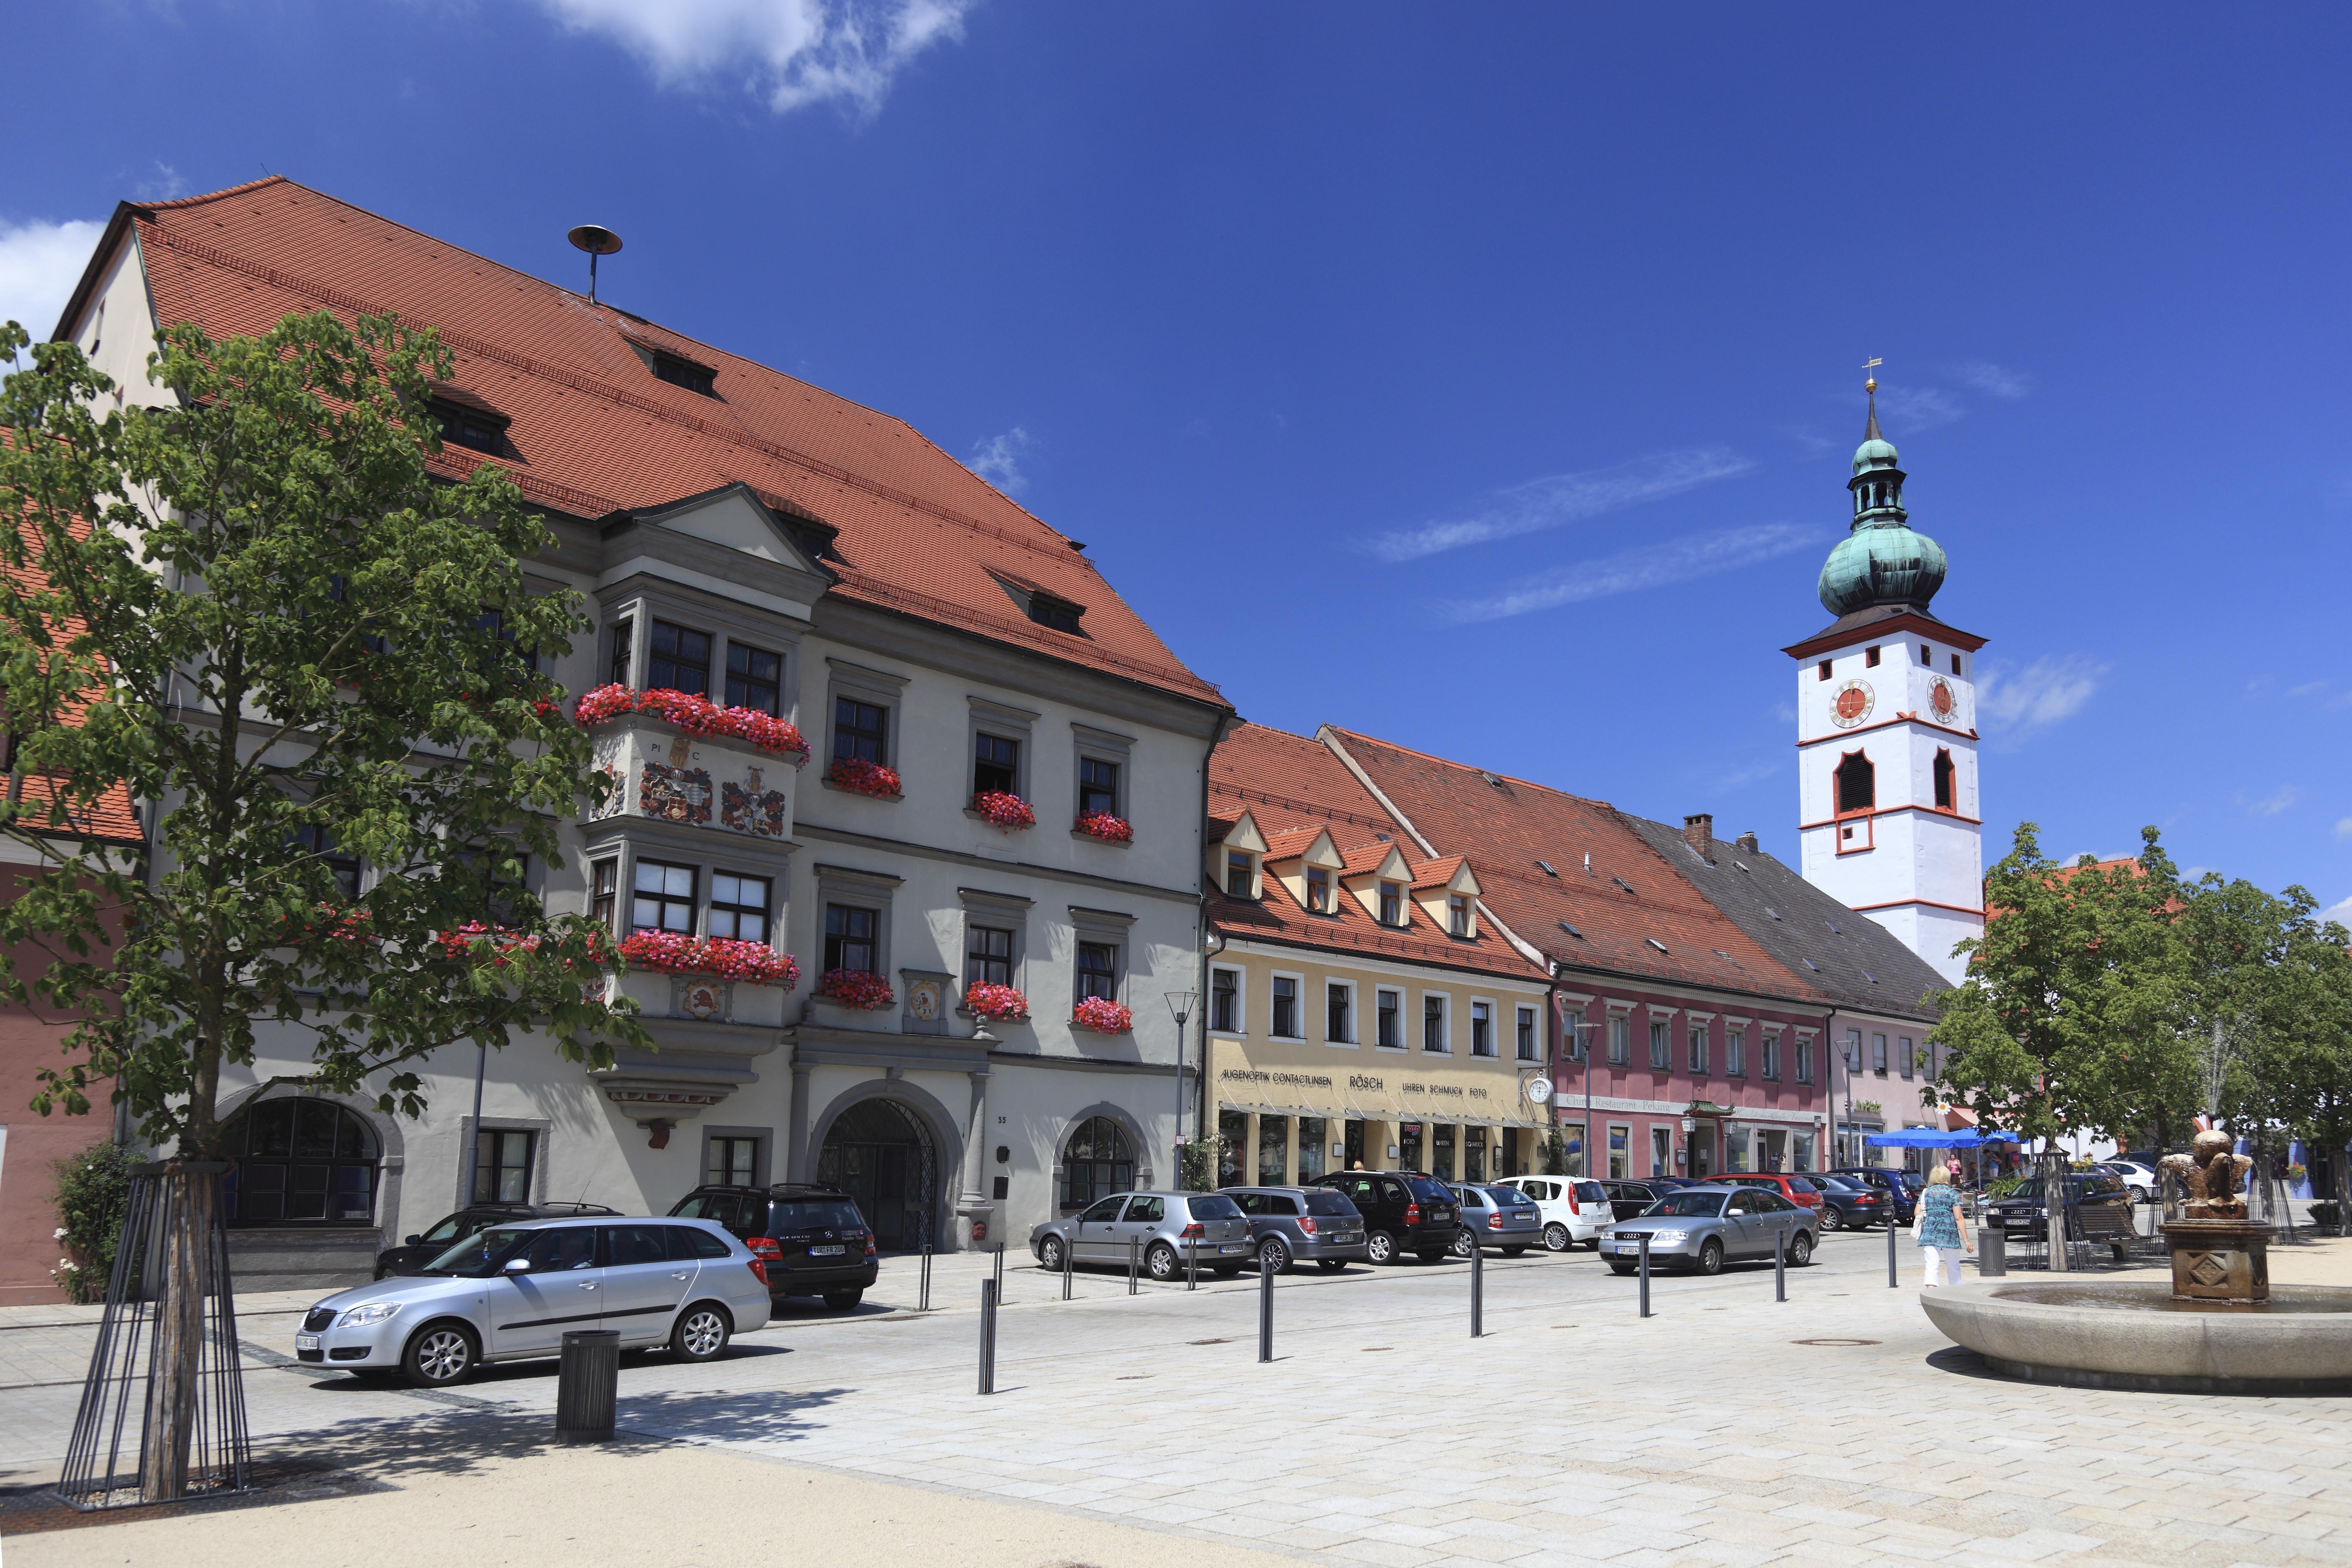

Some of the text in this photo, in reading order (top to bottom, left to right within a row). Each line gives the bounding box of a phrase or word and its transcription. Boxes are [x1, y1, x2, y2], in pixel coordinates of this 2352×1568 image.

[651, 743, 661, 753] PI
[1220, 1069, 1332, 1085] AUGENOPTIK CONTACTLINSEN
[1350, 1074, 1383, 1089] RÖSCH
[1402, 1083, 1487, 1097] UHREN SCHMUCK FOTO
[1595, 1097, 1636, 1110] Restaurant
[1642, 1101, 1670, 1113] Peking
[1790, 1111, 1813, 1121] Verona
